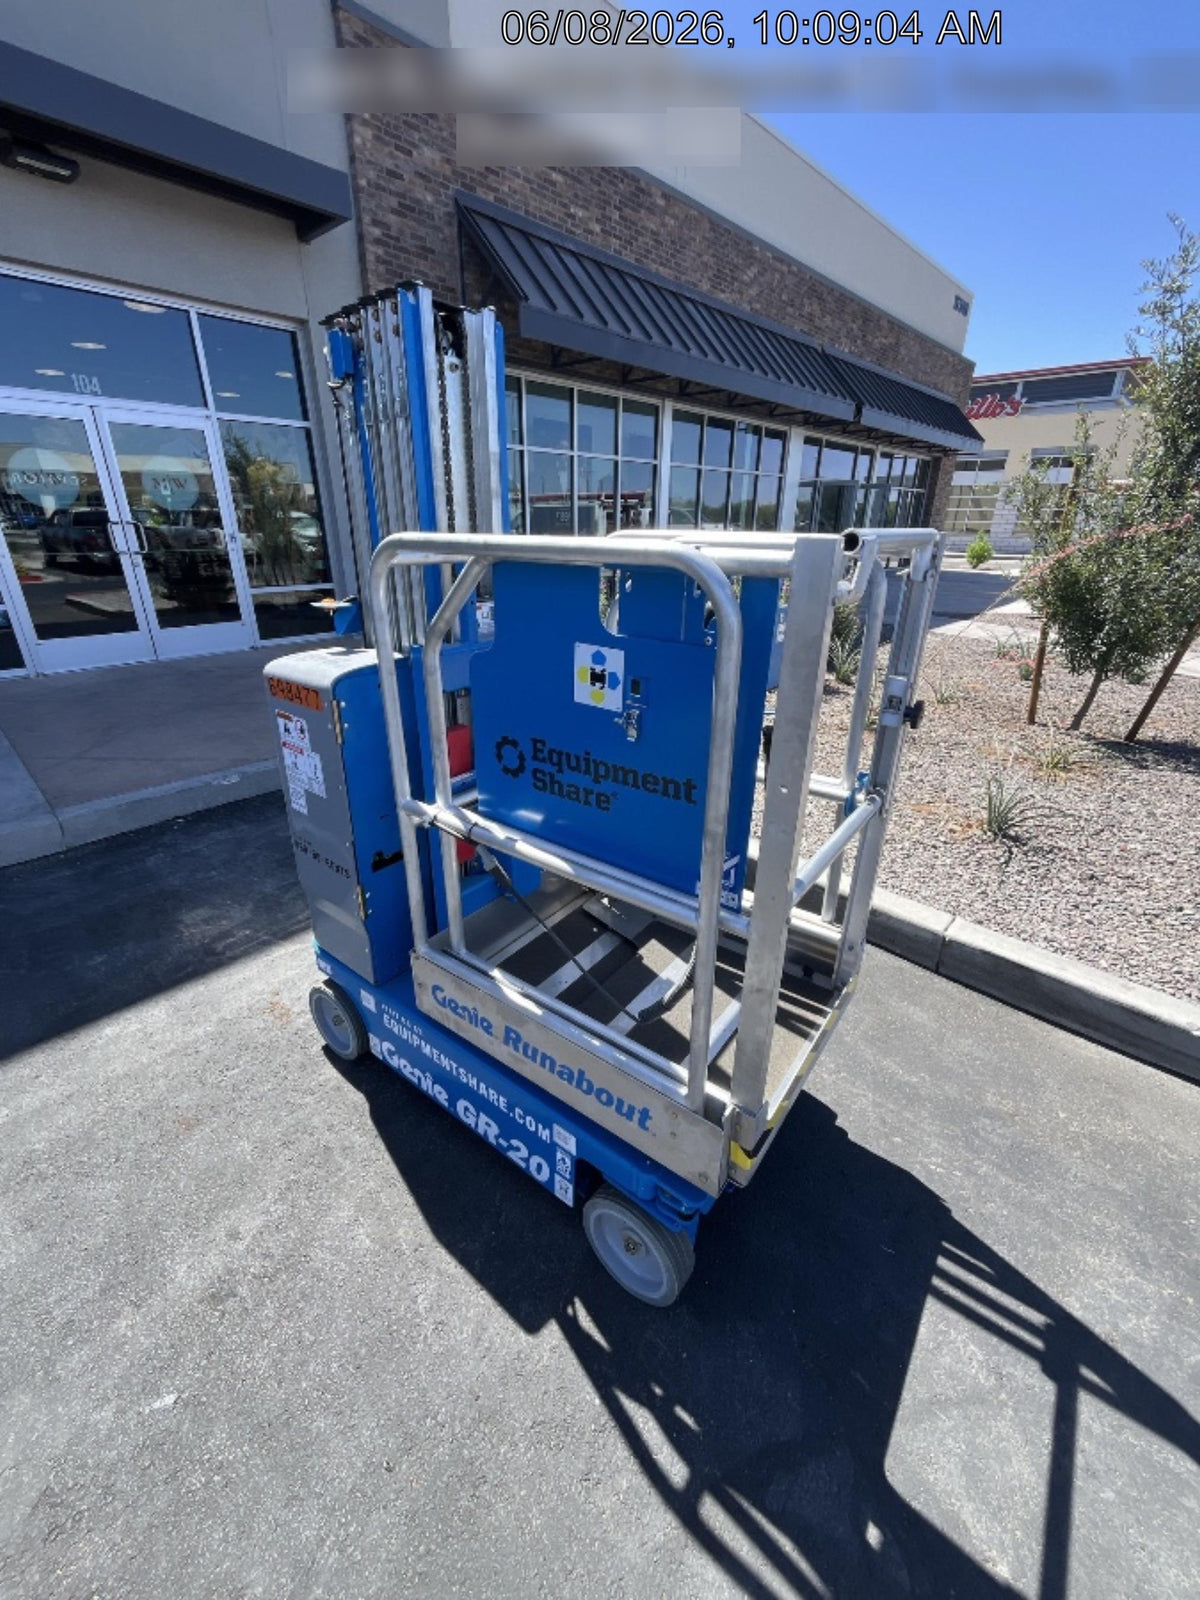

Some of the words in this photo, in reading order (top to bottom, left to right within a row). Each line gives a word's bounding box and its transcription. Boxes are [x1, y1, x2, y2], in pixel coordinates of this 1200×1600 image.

[70, 373, 102, 395] 104
[530, 737, 698, 805] Equipment
[531, 767, 611, 812] Share
[383, 1014, 551, 1144] EQUIPMENTSHARE.COM
[431, 984, 495, 1037] Genie
[502, 1024, 654, 1132] Runabout
[381, 1041, 449, 1108] Genie
[456, 1098, 551, 1183] GR-20
